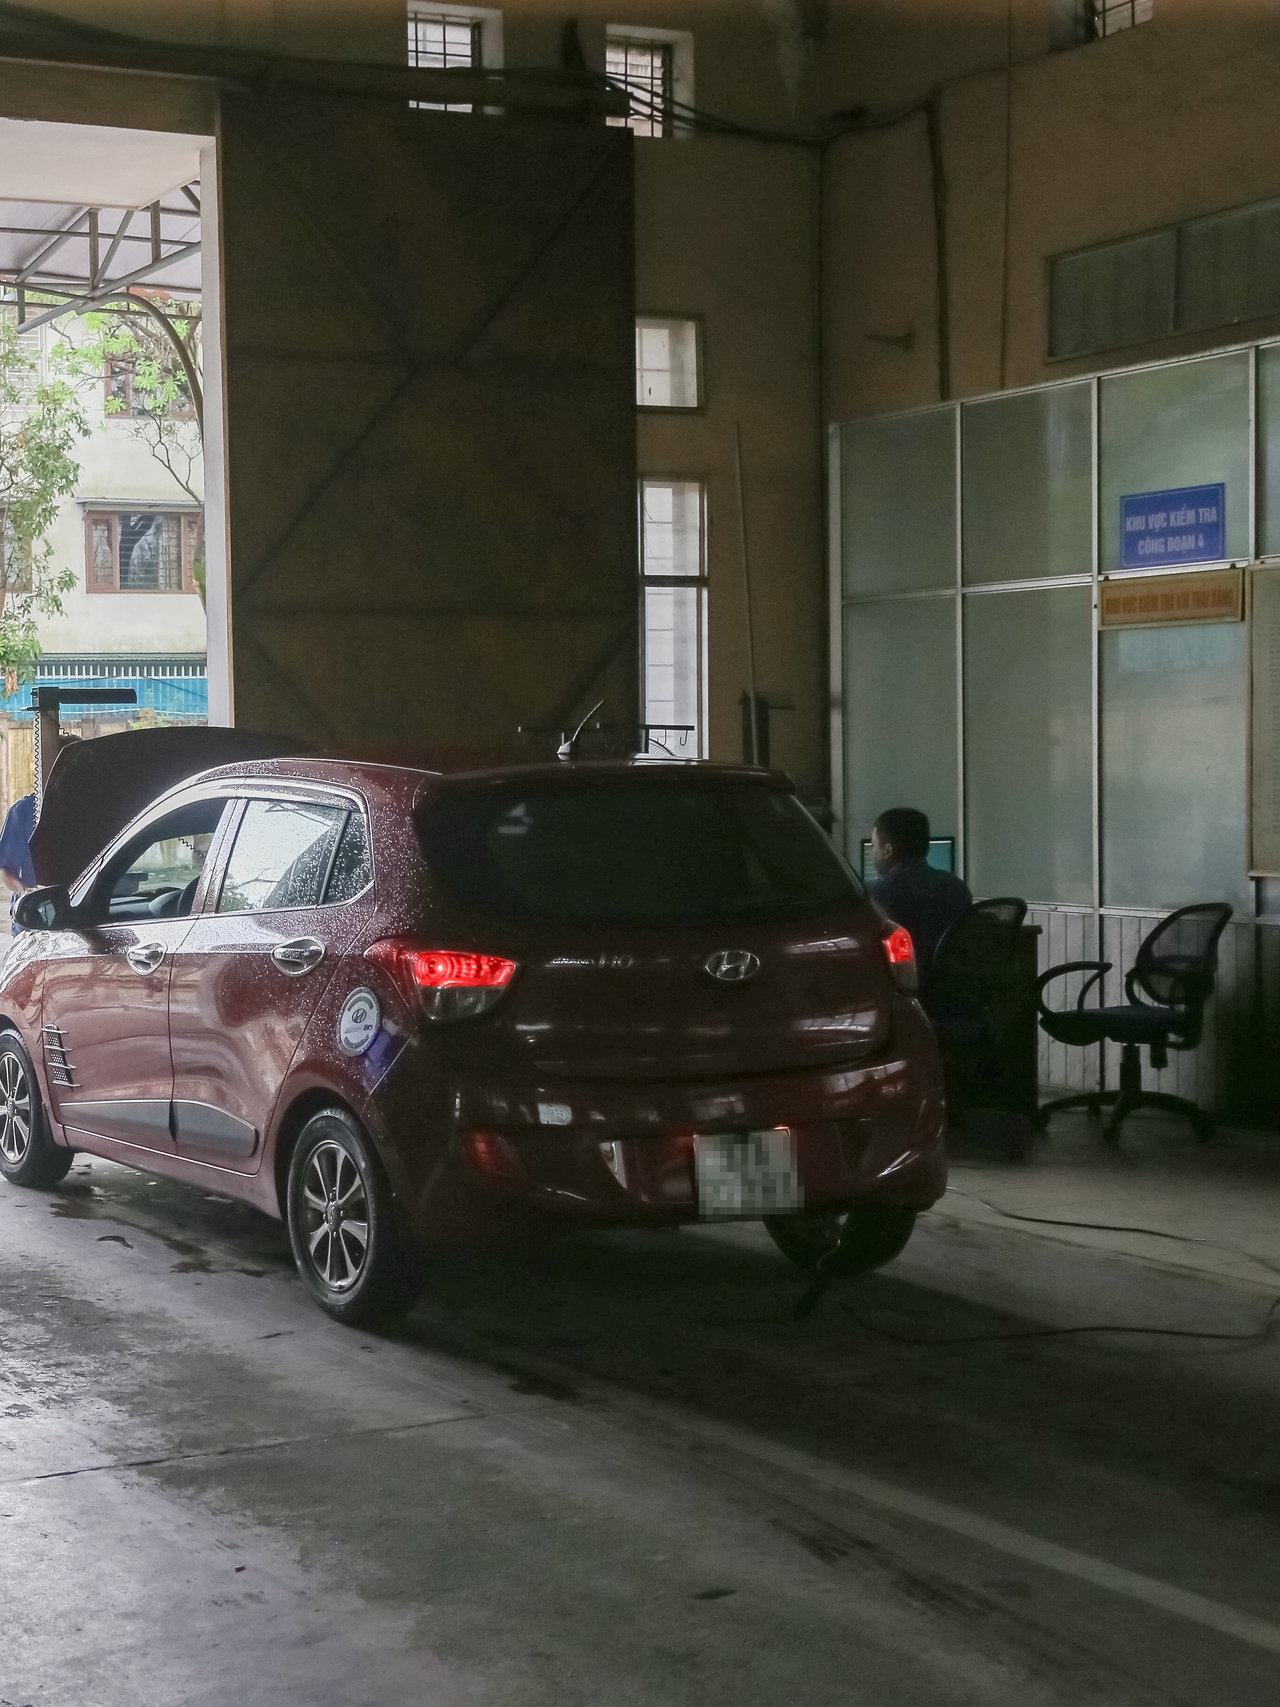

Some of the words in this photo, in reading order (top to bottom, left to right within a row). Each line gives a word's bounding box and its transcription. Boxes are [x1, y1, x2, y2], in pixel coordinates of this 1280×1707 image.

[1126, 515, 1145, 532] KHU
[1148, 512, 1167, 533] VỰC
[1170, 503, 1195, 527] KIỂM
[1199, 506, 1218, 523] TRA
[1138, 535, 1165, 555] CÔNG
[1168, 533, 1195, 554] ĐOẠN
[1198, 533, 1205, 549] 4
